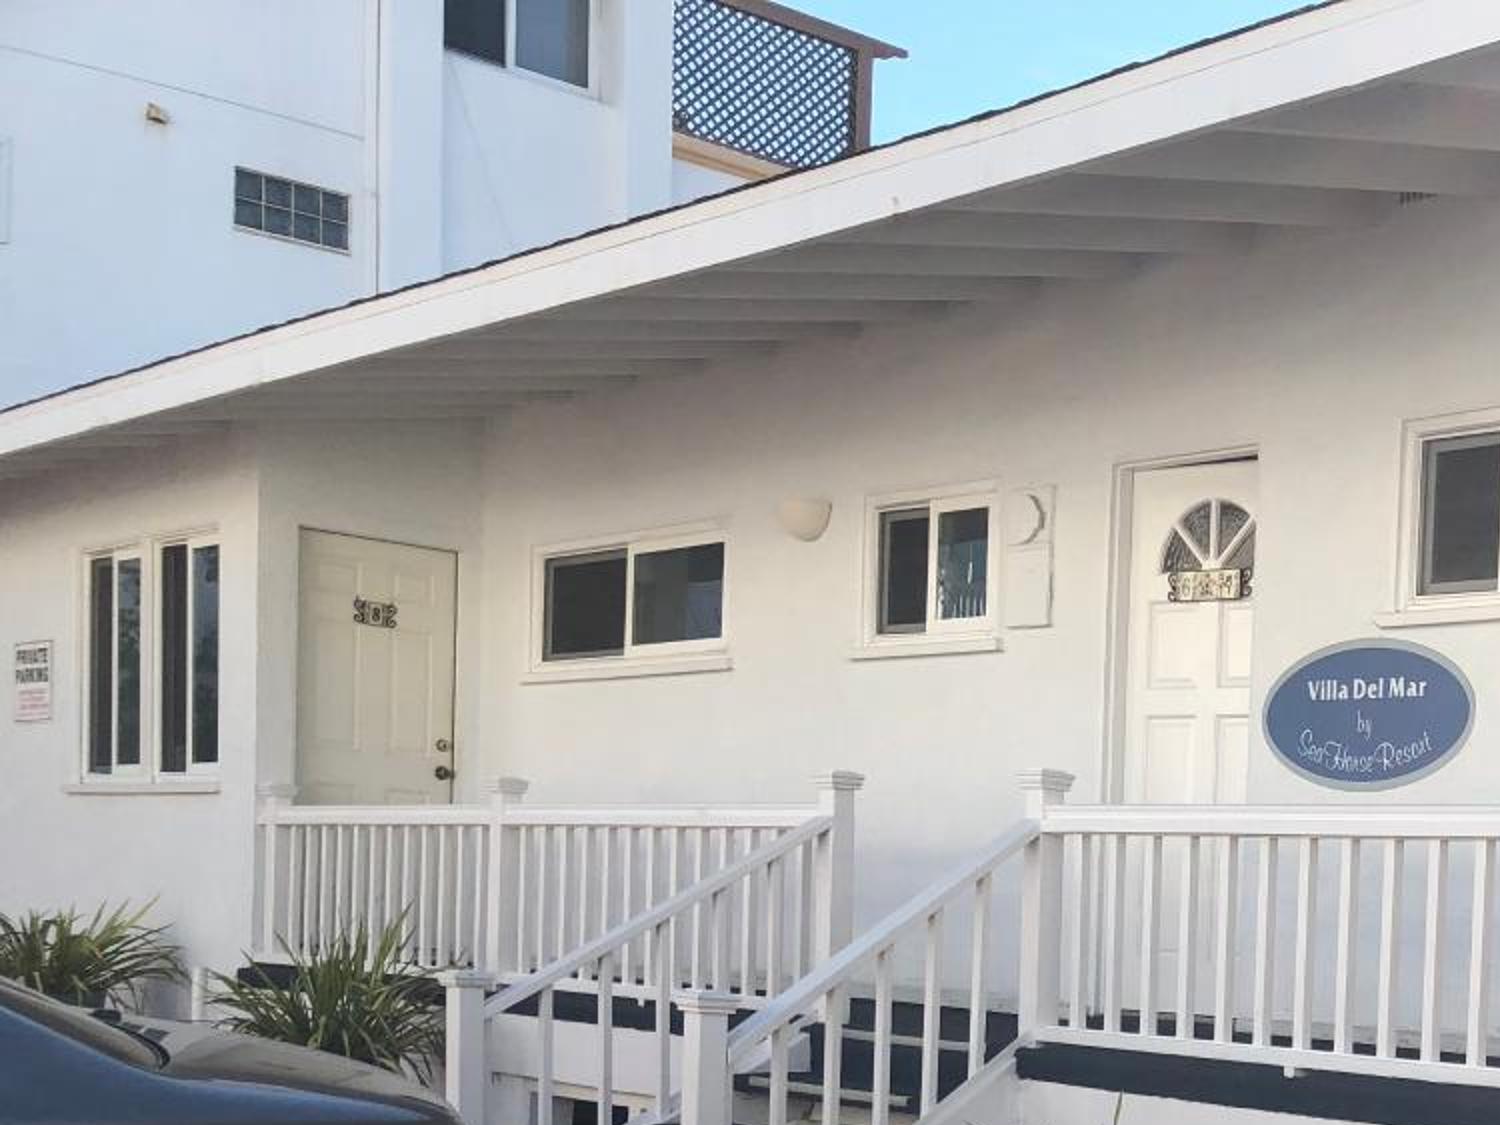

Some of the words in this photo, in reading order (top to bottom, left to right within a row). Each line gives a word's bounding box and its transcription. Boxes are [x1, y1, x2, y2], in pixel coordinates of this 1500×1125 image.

[371, 607, 381, 622] 8
[16, 666, 49, 684] PARKING
[1308, 680, 1349, 701] Villa
[1353, 677, 1384, 699] Del
[1389, 676, 1427, 699] Mar
[1356, 709, 1372, 741] by
[1298, 729, 1324, 764] Sea
[1324, 741, 1374, 773] Horse
[1374, 730, 1432, 771] Resort
